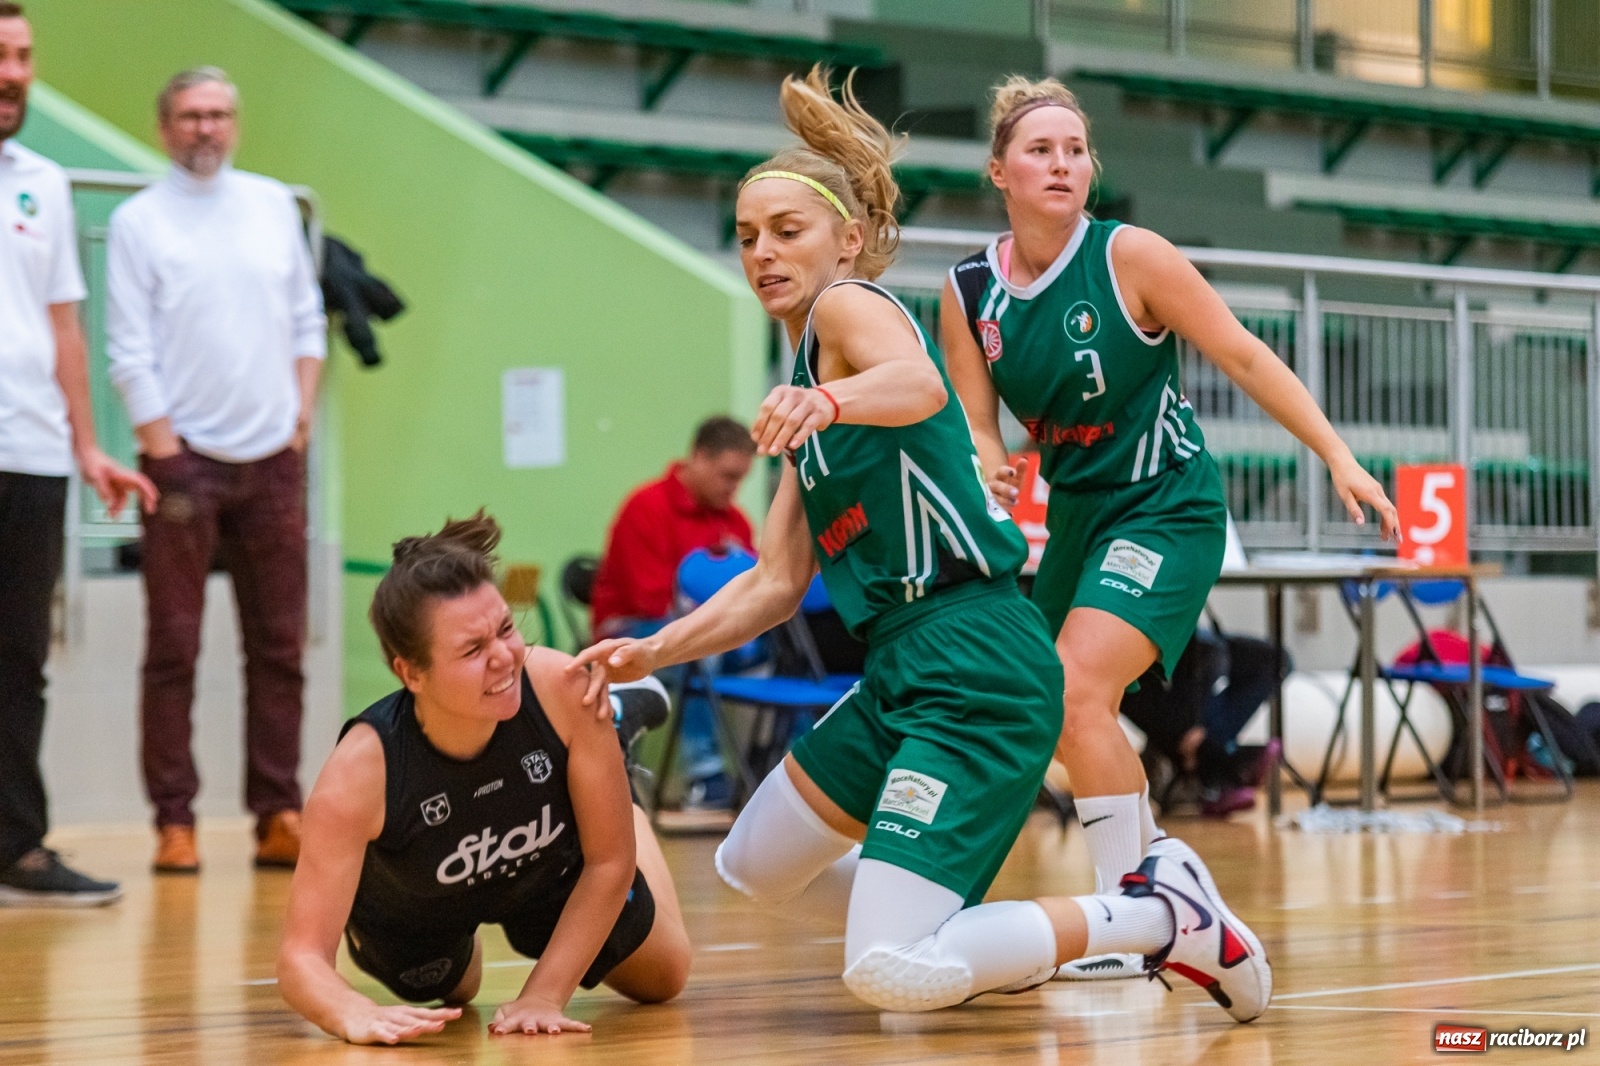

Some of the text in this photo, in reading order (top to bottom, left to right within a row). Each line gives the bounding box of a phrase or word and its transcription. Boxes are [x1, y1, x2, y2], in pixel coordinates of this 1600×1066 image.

[1074, 348, 1107, 402] 3
[1409, 472, 1455, 546] 5
[1100, 578, 1144, 598] COLO
[523, 751, 550, 770] STAL
[436, 803, 566, 885] Stal
[875, 820, 921, 839] COLO
